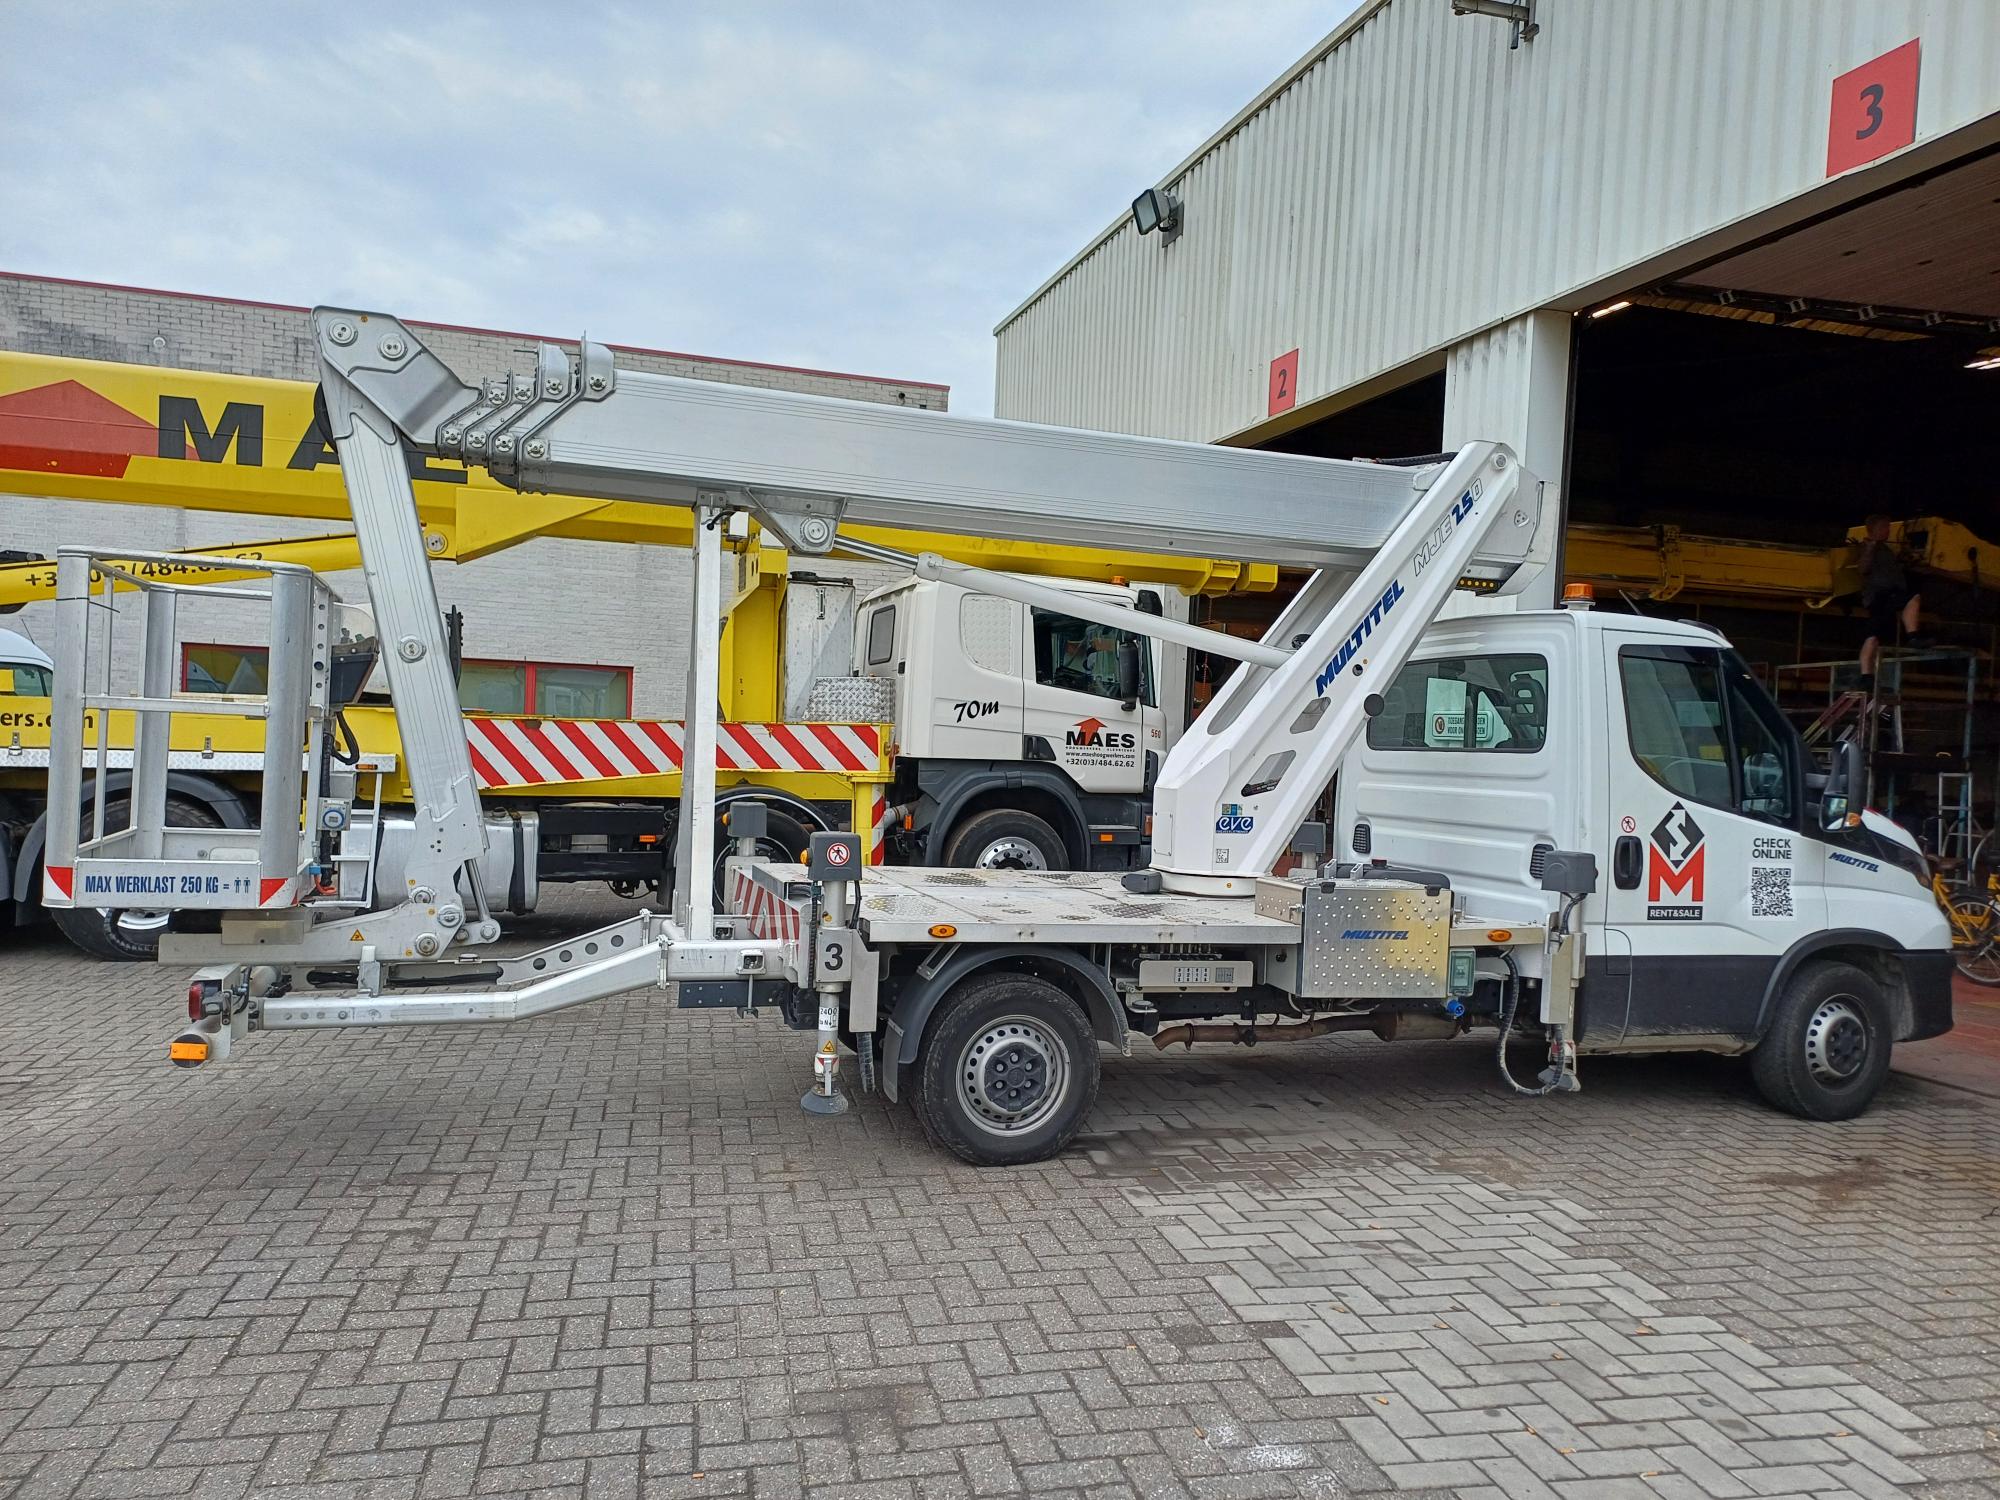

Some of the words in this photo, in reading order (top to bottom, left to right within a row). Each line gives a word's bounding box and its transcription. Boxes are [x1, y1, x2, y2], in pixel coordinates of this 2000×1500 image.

[1856, 84, 1884, 140] 3
[1277, 368, 1287, 399] 2
[1315, 579, 1405, 697] MULTITEL
[1413, 514, 1453, 577] MJE
[953, 700, 999, 723] 70m
[1066, 731, 1135, 749] MAES
[1066, 759, 1135, 768] +32(0)3/484.62.62
[1219, 817, 1252, 831] eve
[1752, 837, 1792, 849] CHECK
[1752, 848, 1793, 860] ONLINE
[1828, 851, 1879, 873] MULTITEL
[85, 876, 112, 893] MAX
[115, 876, 176, 894] WERKLAST
[181, 876, 202, 894] 250
[205, 876, 219, 893] KG
[1650, 908, 1701, 918] RENT&SALE
[1340, 930, 1410, 940] MULTITEL
[824, 943, 843, 971] 3
